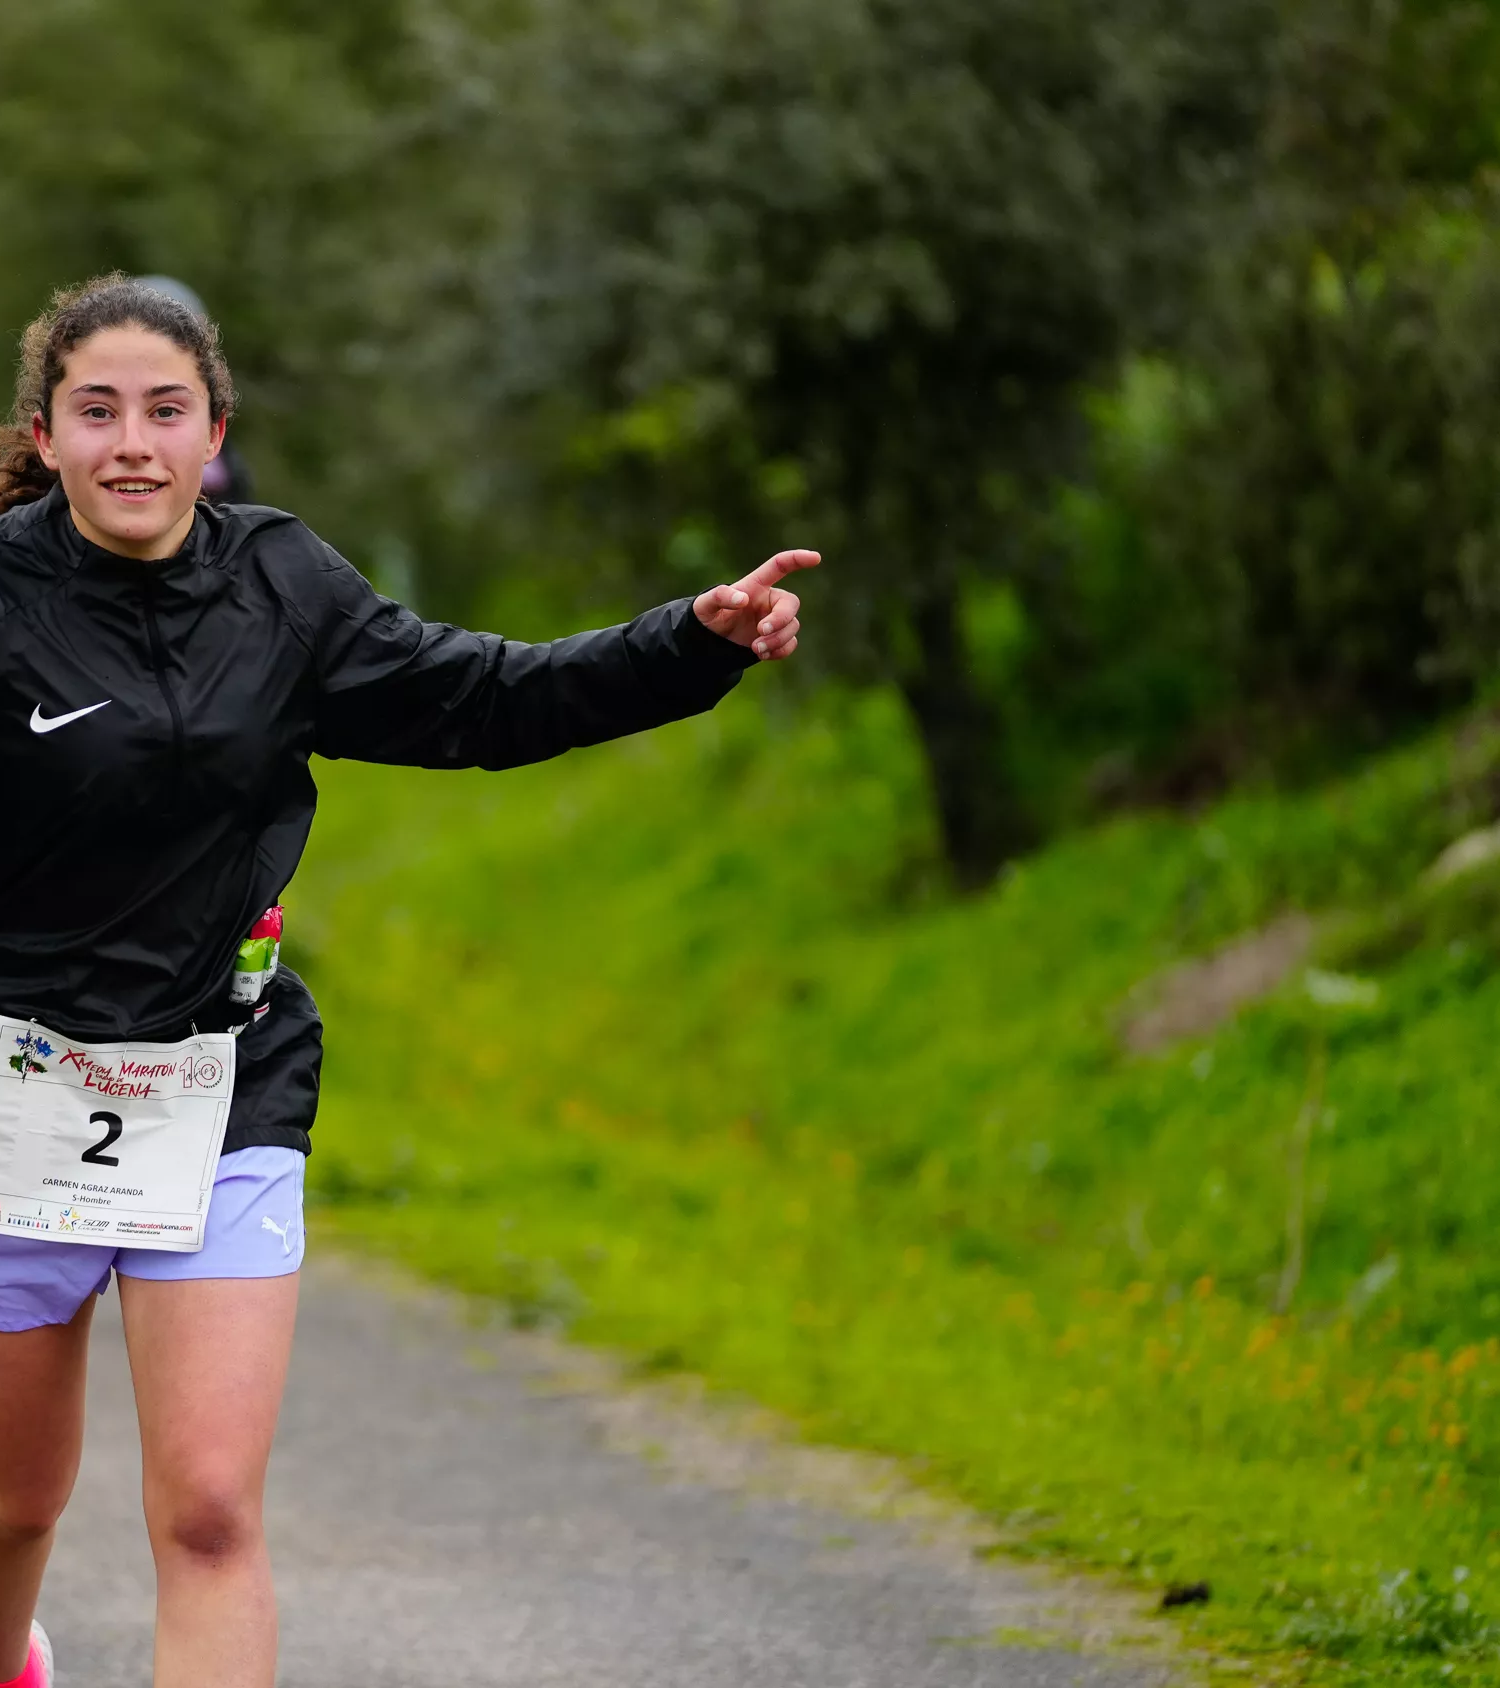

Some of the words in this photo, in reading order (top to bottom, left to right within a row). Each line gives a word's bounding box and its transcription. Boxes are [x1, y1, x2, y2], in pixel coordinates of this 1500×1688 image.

[119, 1060, 177, 1078] MARATÓN
[84, 1072, 161, 1098] LUCENA
[81, 1111, 123, 1167] 2
[42, 1178, 79, 1189] CARMEN
[81, 1183, 108, 1193] AGRAZ
[110, 1187, 144, 1196] ARANDA
[72, 1194, 112, 1205] S-Hombre
[118, 1221, 193, 1232] mediamaratonlucena.com
